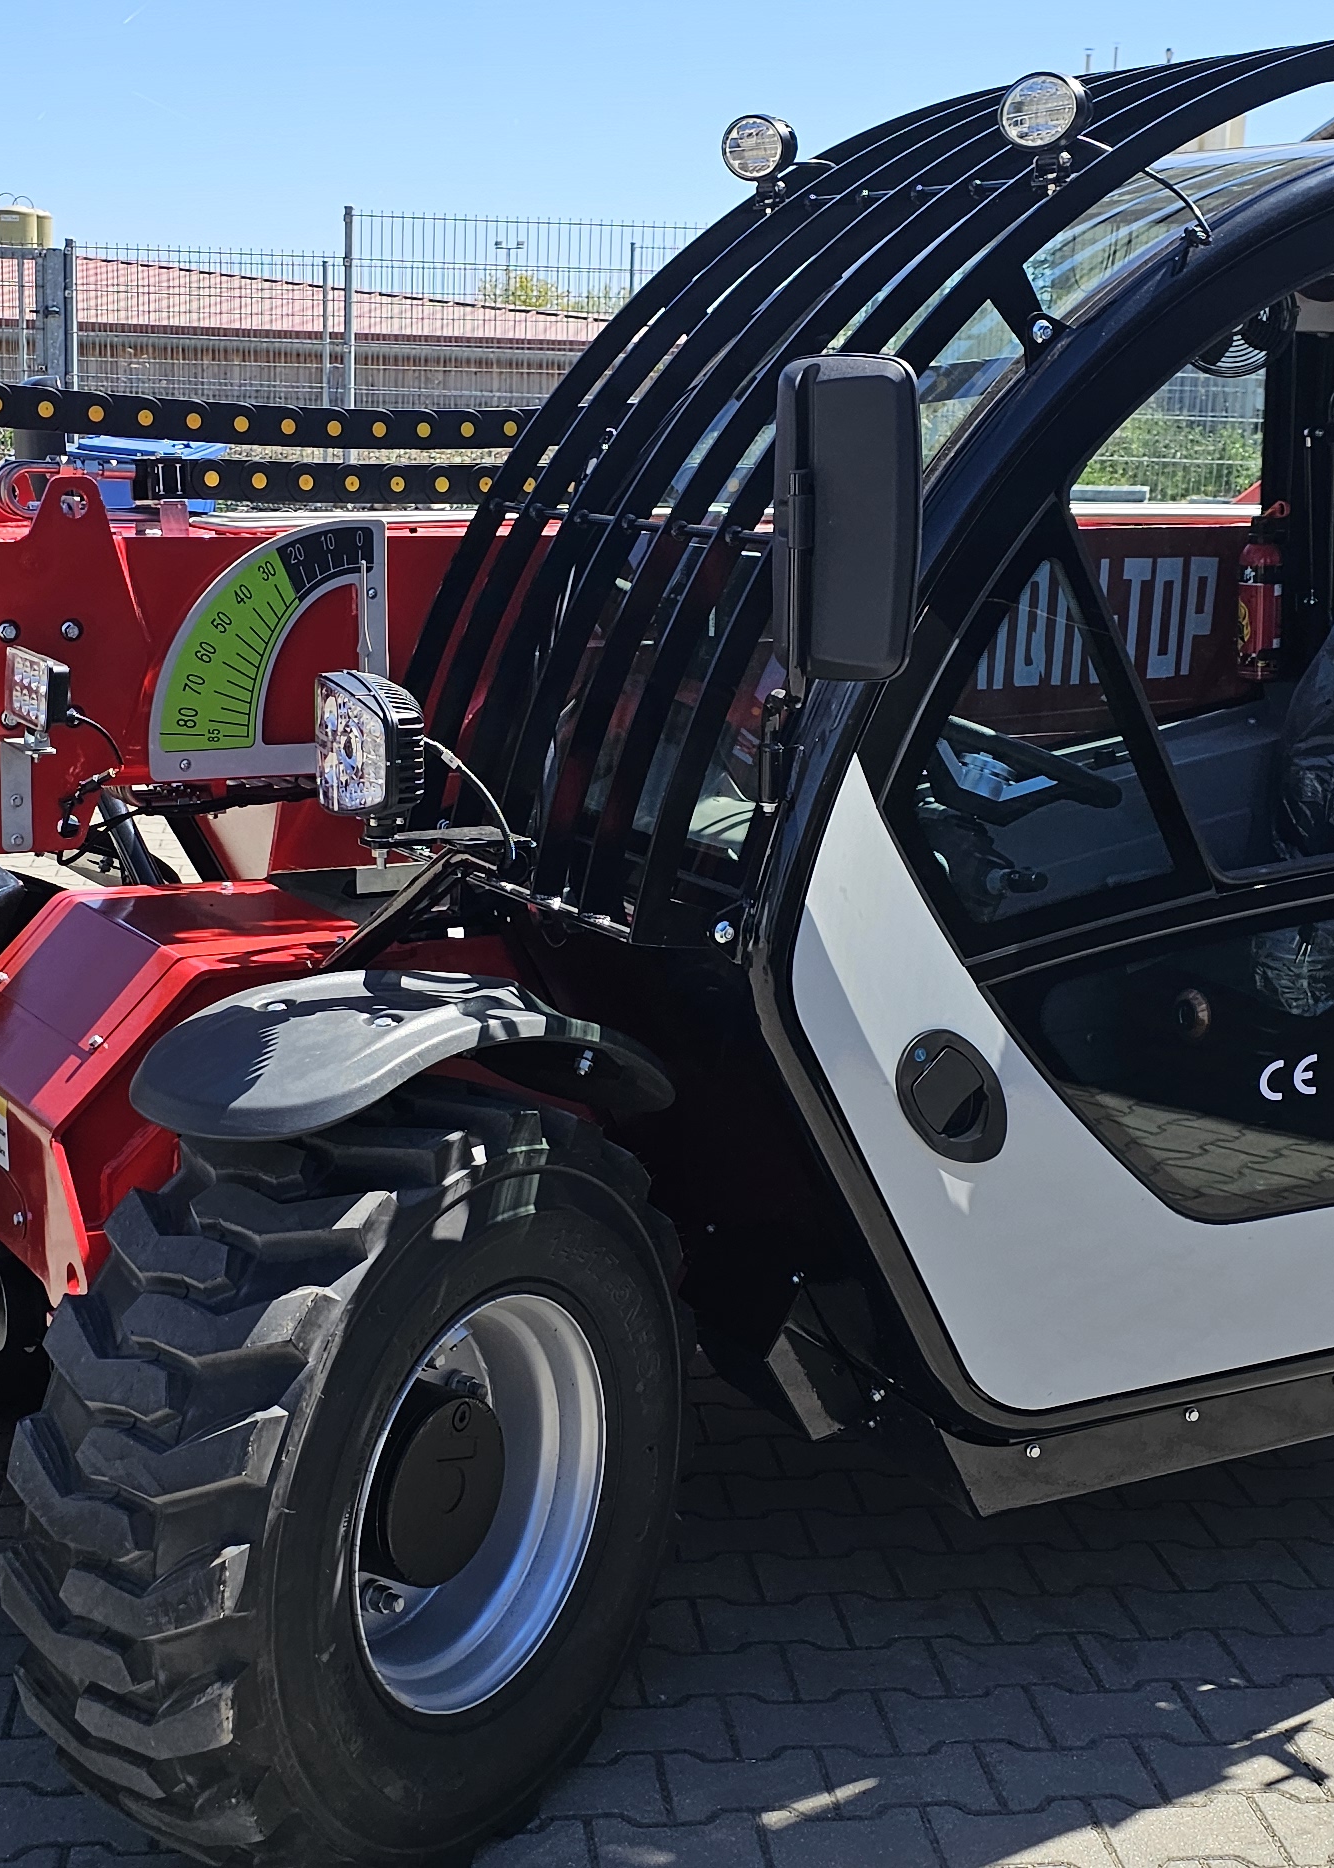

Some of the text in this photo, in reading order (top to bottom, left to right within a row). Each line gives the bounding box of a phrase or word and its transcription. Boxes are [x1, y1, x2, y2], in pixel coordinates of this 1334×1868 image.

[321, 533, 335, 550] 10
[356, 530, 364, 547] 0
[287, 544, 305, 565] 20
[257, 561, 277, 582] 30
[234, 584, 253, 605] 40
[210, 611, 232, 634] 50
[195, 641, 217, 664] 60
[183, 673, 206, 695] 70
[177, 707, 198, 729] 80
[207, 728, 221, 743] 85
[1259, 1053, 1318, 1101] CE
